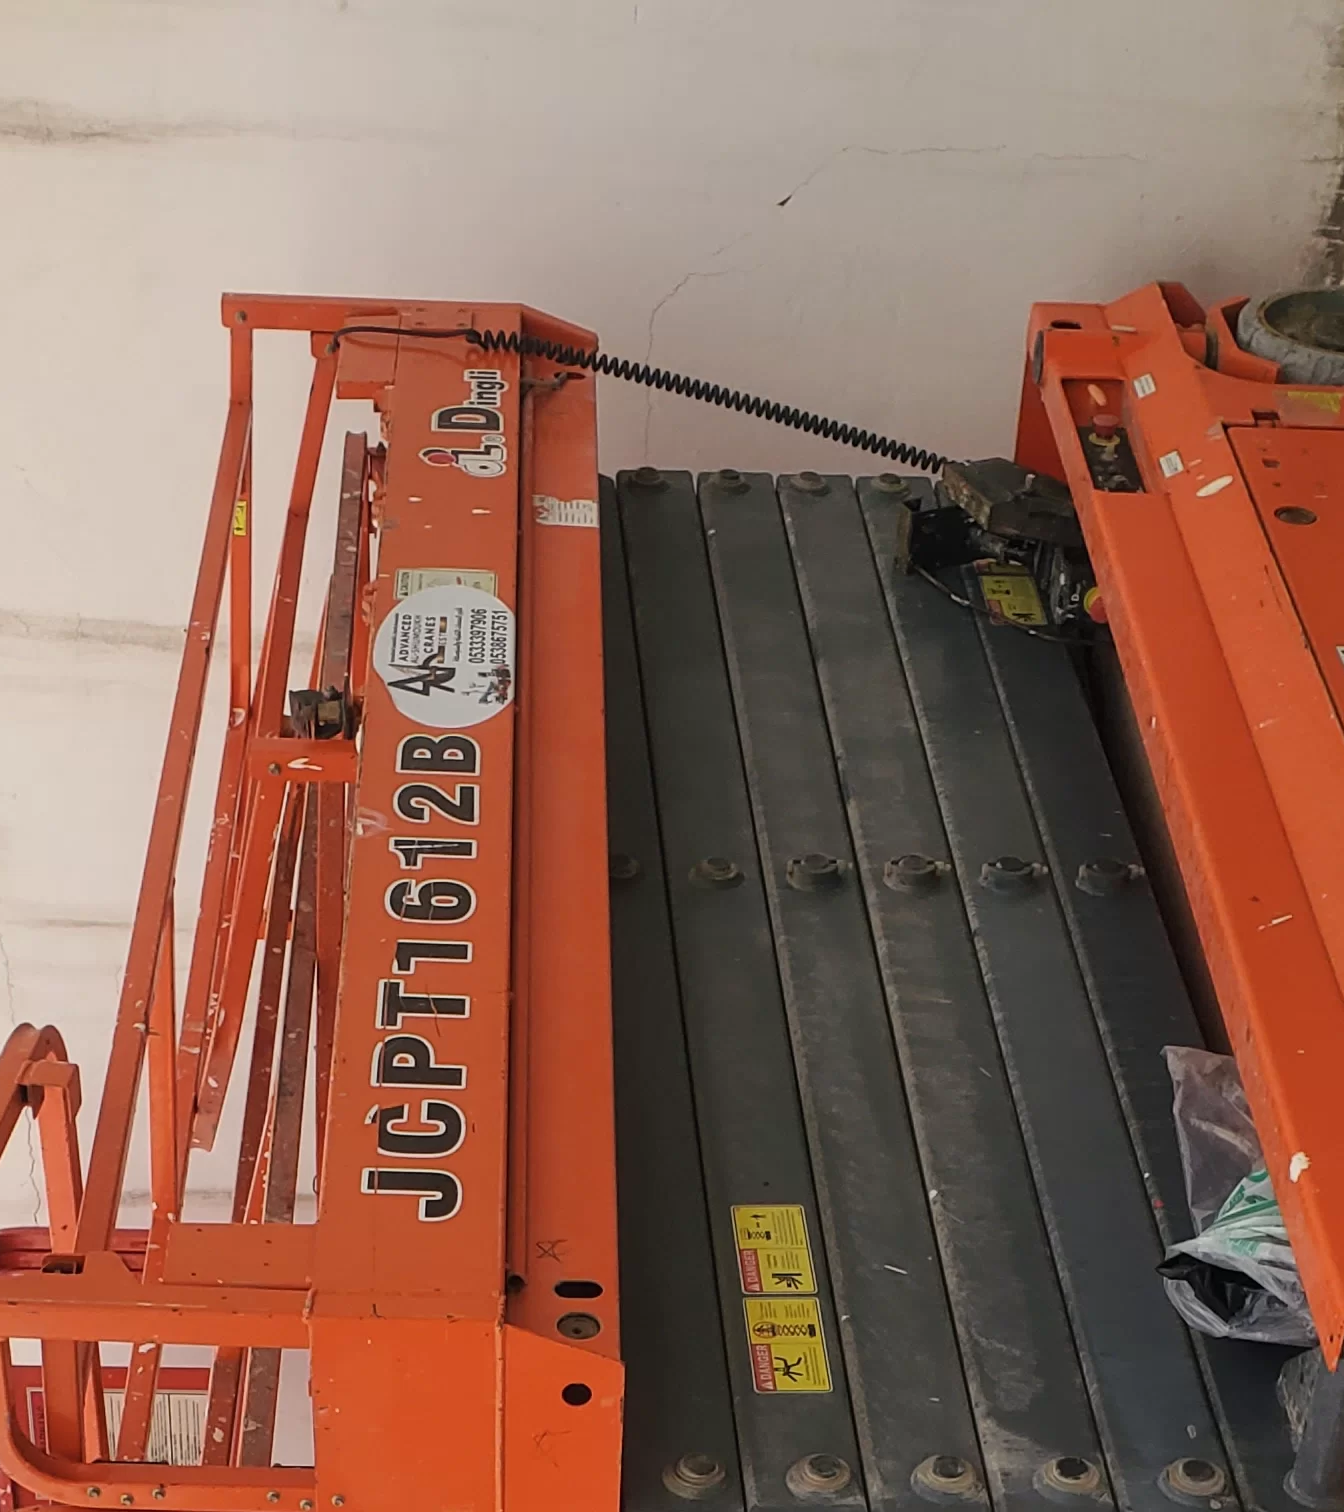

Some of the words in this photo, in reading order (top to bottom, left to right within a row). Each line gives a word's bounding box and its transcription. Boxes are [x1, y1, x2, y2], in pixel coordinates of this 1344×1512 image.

[431, 369, 508, 431] Dingli
[399, 614, 412, 662] ADVANCED
[411, 615, 421, 664] AL-SHUMOUKH
[423, 616, 436, 654] CRANES
[468, 608, 487, 664] 0533397906
[490, 610, 509, 664] 0538675751
[362, 734, 480, 1220] JCPT1612B
[743, 1250, 759, 1283] DANGER
[757, 1345, 771, 1380] DANGER
